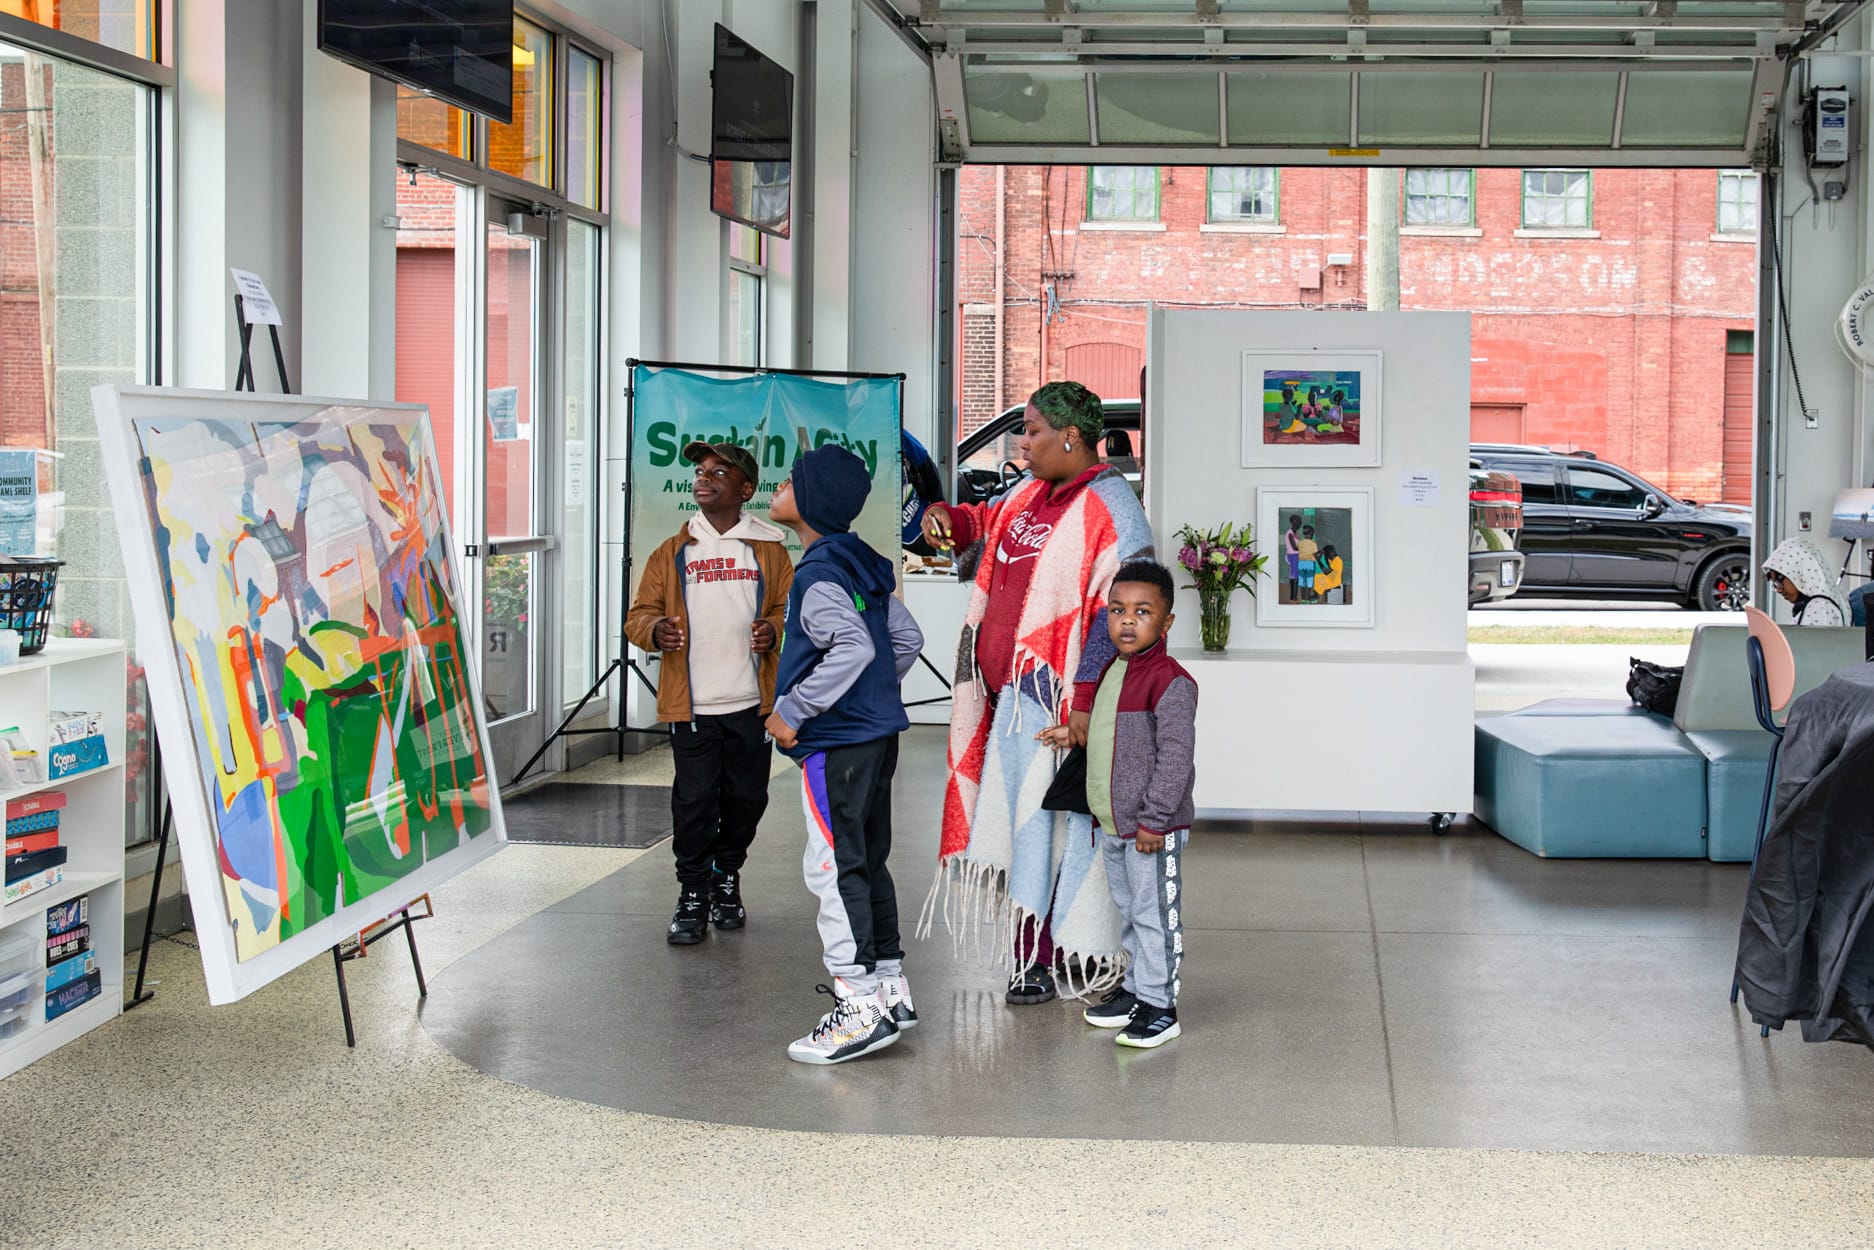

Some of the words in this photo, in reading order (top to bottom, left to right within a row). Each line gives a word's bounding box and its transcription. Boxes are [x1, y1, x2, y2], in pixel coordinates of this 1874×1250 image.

[1850, 313, 1863, 347] ROBERT
[1858, 288, 1874, 302] VAL
[0, 476, 32, 486] OMMUNITY
[663, 479, 673, 493] A
[676, 480, 693, 493] vis
[0, 487, 13, 496] AME
[15, 487, 32, 496] SHELF
[686, 502, 700, 511] Env
[747, 501, 770, 510] Exhibiti
[696, 568, 759, 584] FORMERS
